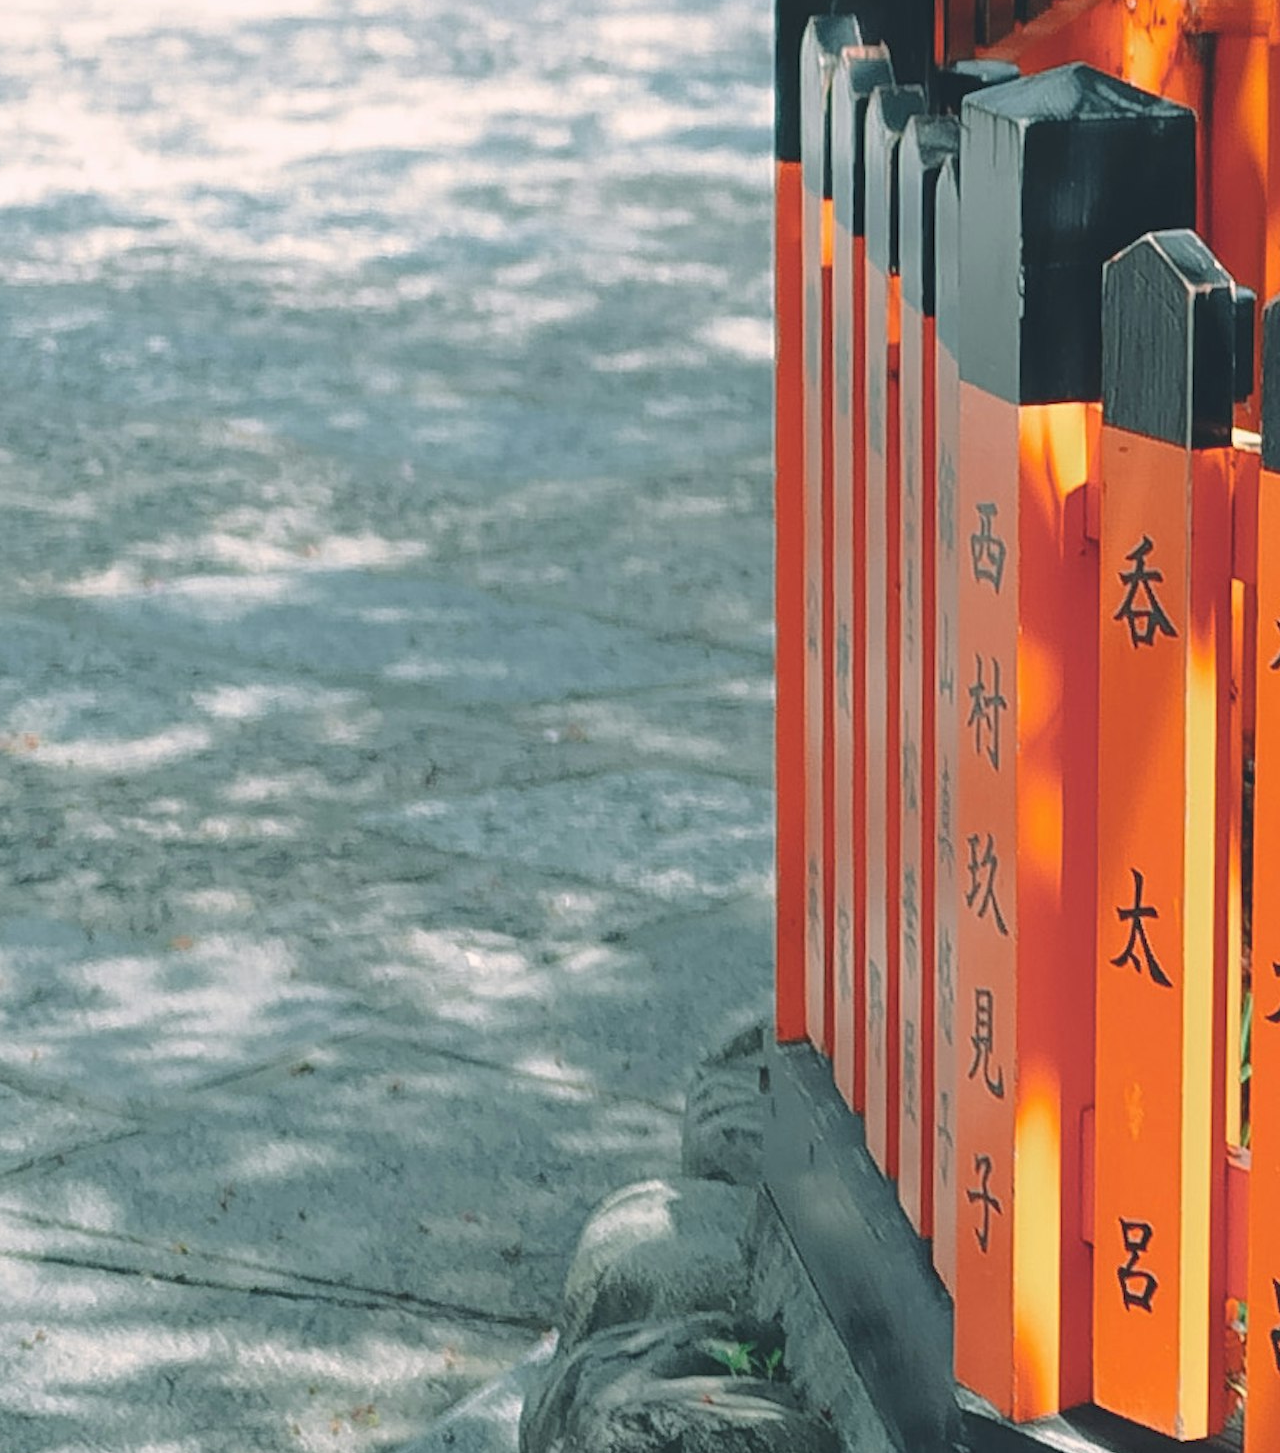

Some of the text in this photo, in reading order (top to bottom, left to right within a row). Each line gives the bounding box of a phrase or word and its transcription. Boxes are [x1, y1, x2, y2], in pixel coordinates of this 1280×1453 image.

[967, 503, 1007, 1252] 西村玖見子
[1111, 534, 1177, 1313] 呑太呂
